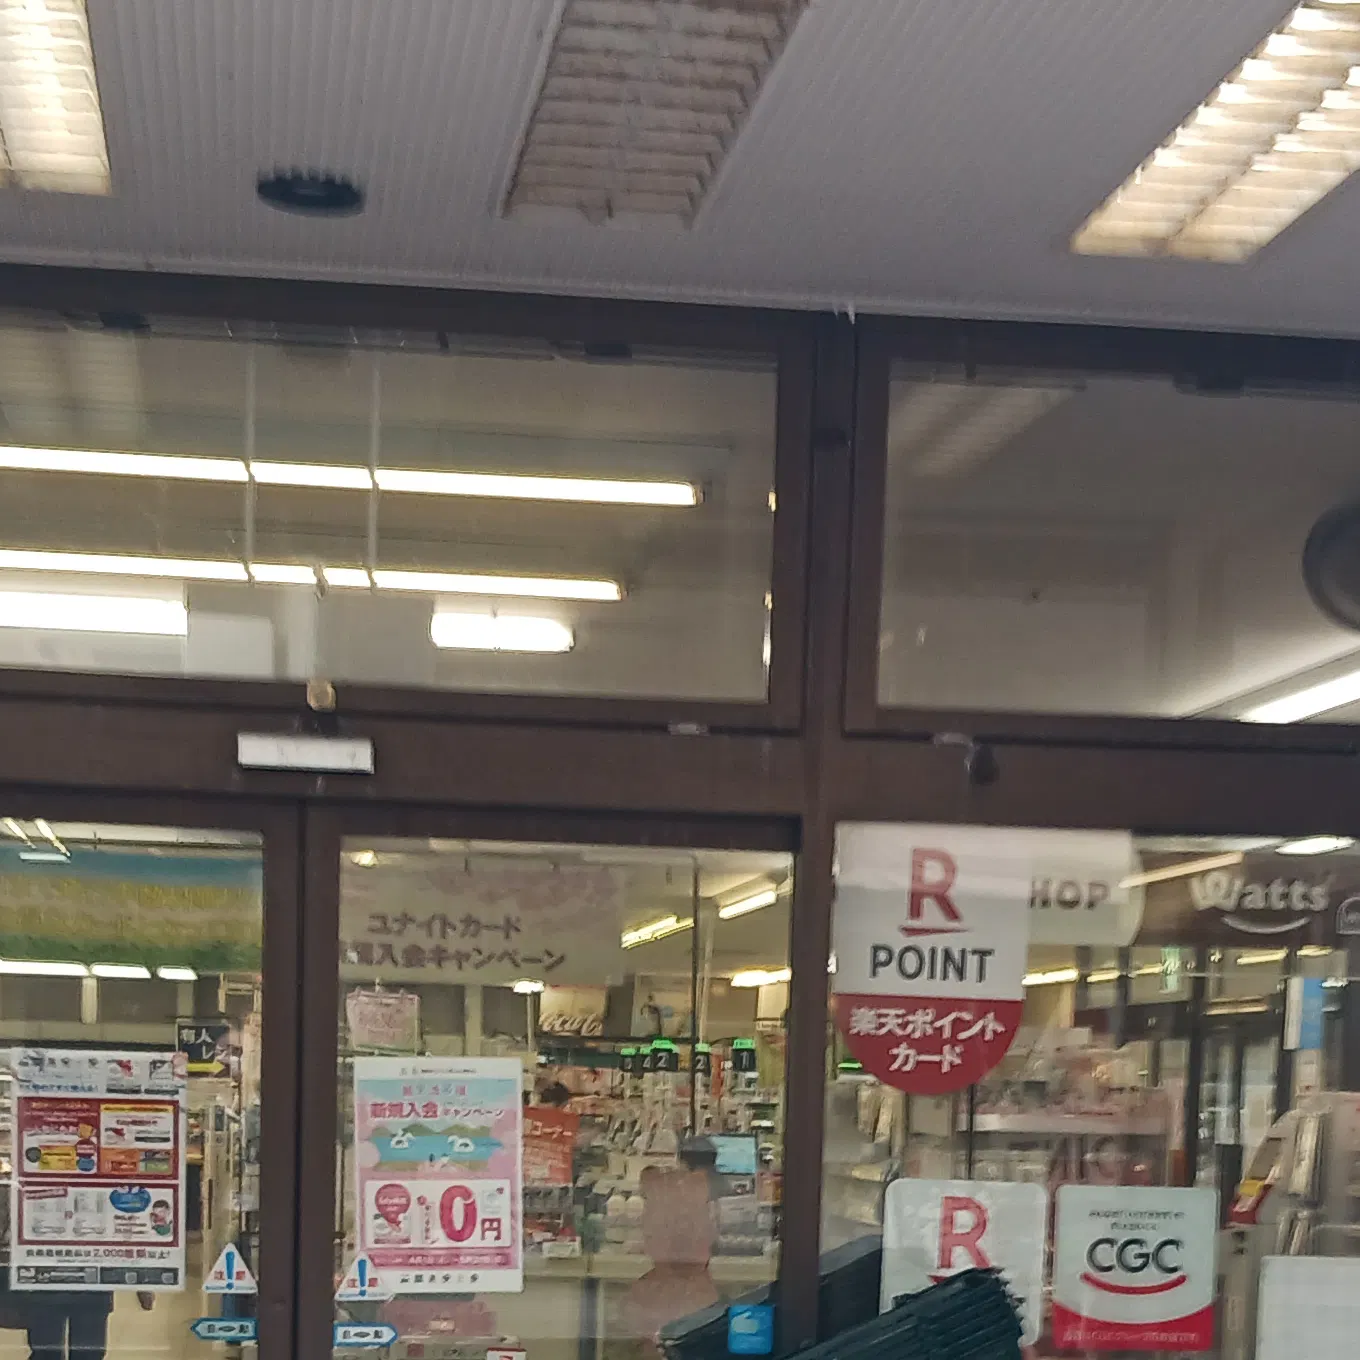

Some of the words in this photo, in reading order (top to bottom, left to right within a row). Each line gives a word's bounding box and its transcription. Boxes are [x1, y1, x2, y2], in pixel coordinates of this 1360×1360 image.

[907, 847, 962, 922] R
[1191, 871, 1329, 912] Watts
[367, 913, 521, 940] ユナイトカード
[869, 945, 995, 983] POINT
[849, 1007, 1006, 1042] 楽天ポイント
[656, 1051, 669, 1068] 2
[695, 1054, 706, 1070] 2
[889, 1042, 963, 1073] カード
[937, 1196, 992, 1269] R
[1086, 1237, 1185, 1274] CGC
